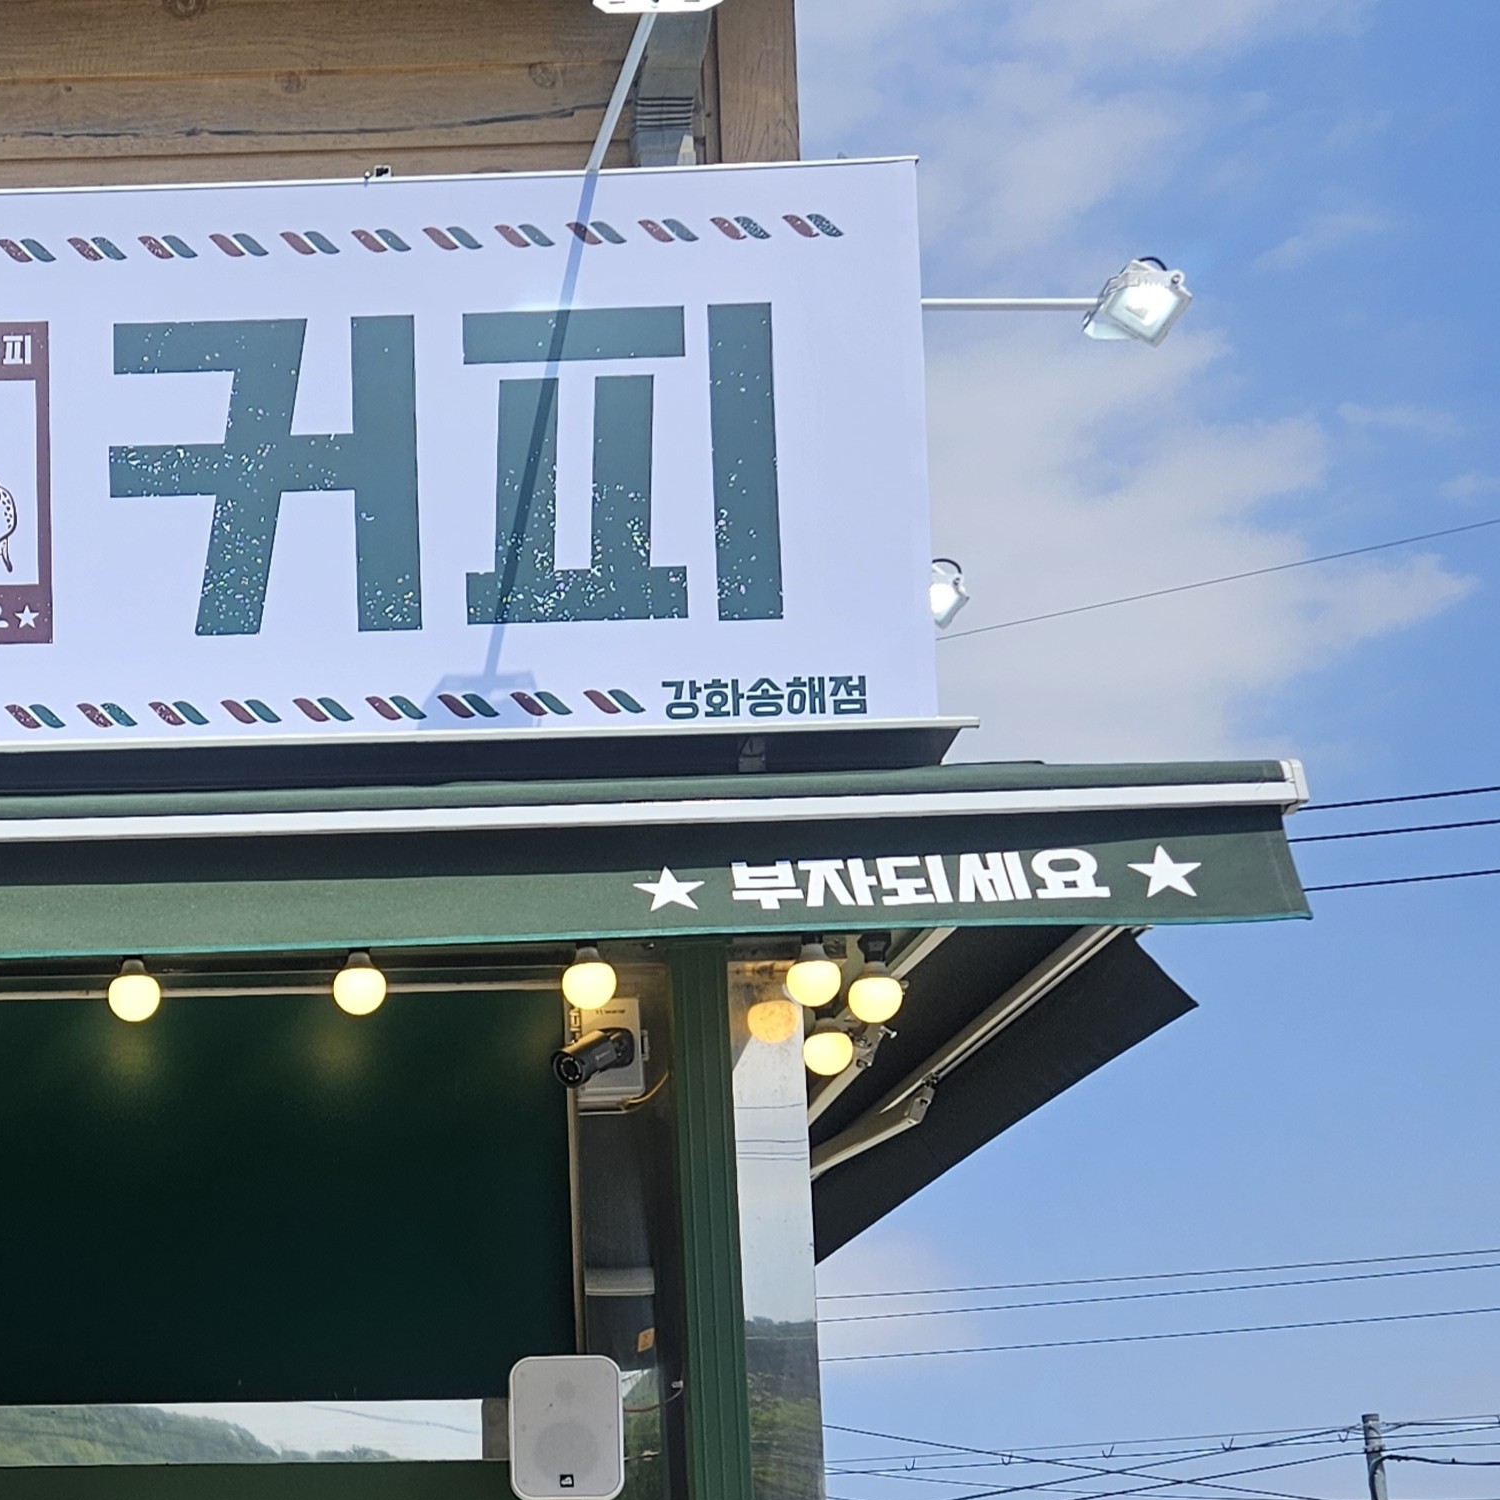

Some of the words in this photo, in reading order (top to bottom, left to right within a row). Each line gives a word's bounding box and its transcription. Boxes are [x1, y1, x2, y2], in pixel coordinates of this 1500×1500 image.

[109, 302, 784, 636] 커피
[661, 675, 868, 720] 강화송해점
[730, 848, 1111, 910] 부자되세요
